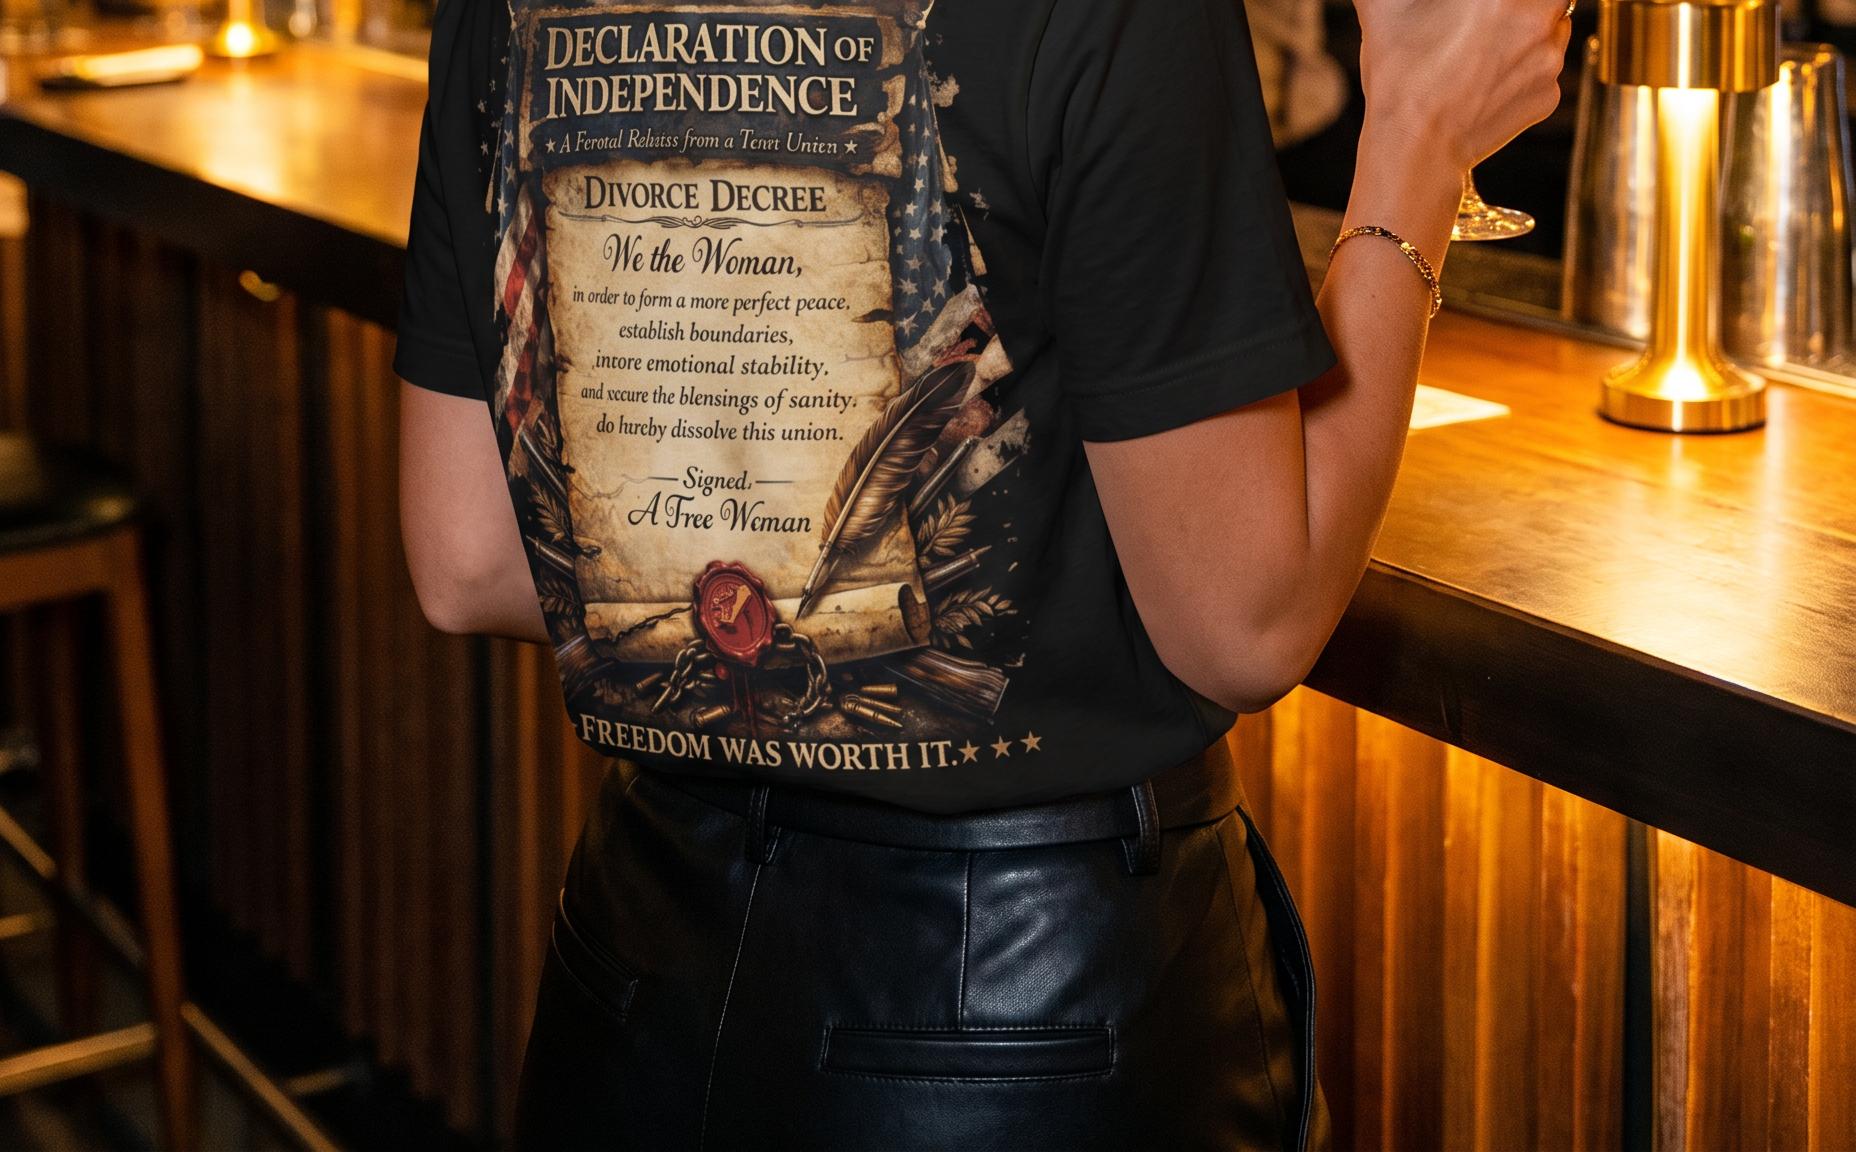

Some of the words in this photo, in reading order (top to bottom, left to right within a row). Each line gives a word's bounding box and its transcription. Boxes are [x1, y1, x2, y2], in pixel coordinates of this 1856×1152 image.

[544, 22, 828, 71] DECLARATION
[834, 36, 874, 62] OF
[546, 73, 858, 119] INDEPENDENCE
[559, 133, 571, 154] A
[679, 128, 719, 153] from
[724, 136, 734, 148] a
[584, 176, 699, 209] DIVORCE
[709, 179, 826, 212] DECREE
[603, 233, 644, 272] We
[650, 238, 685, 273] the
[692, 236, 802, 278] Woman,
[573, 285, 584, 303] in
[588, 286, 620, 305] order
[623, 291, 636, 306] to
[635, 288, 672, 313] form
[676, 296, 686, 308] a
[690, 296, 729, 310] more
[732, 290, 791, 317] perfect
[619, 320, 685, 341] establish
[690, 322, 793, 346] boundaries,
[647, 354, 735, 375] emotional
[581, 382, 604, 400] and
[652, 385, 675, 405] the
[764, 388, 788, 415] of
[596, 412, 615, 434] do
[671, 418, 737, 440] dissolve
[743, 421, 775, 441] this
[781, 422, 843, 441] union.
[627, 491, 662, 525] A
[580, 713, 713, 761] FREEDOM
[717, 736, 782, 767] WAS
[787, 741, 911, 770] WORTH
[917, 740, 958, 768] IT.
